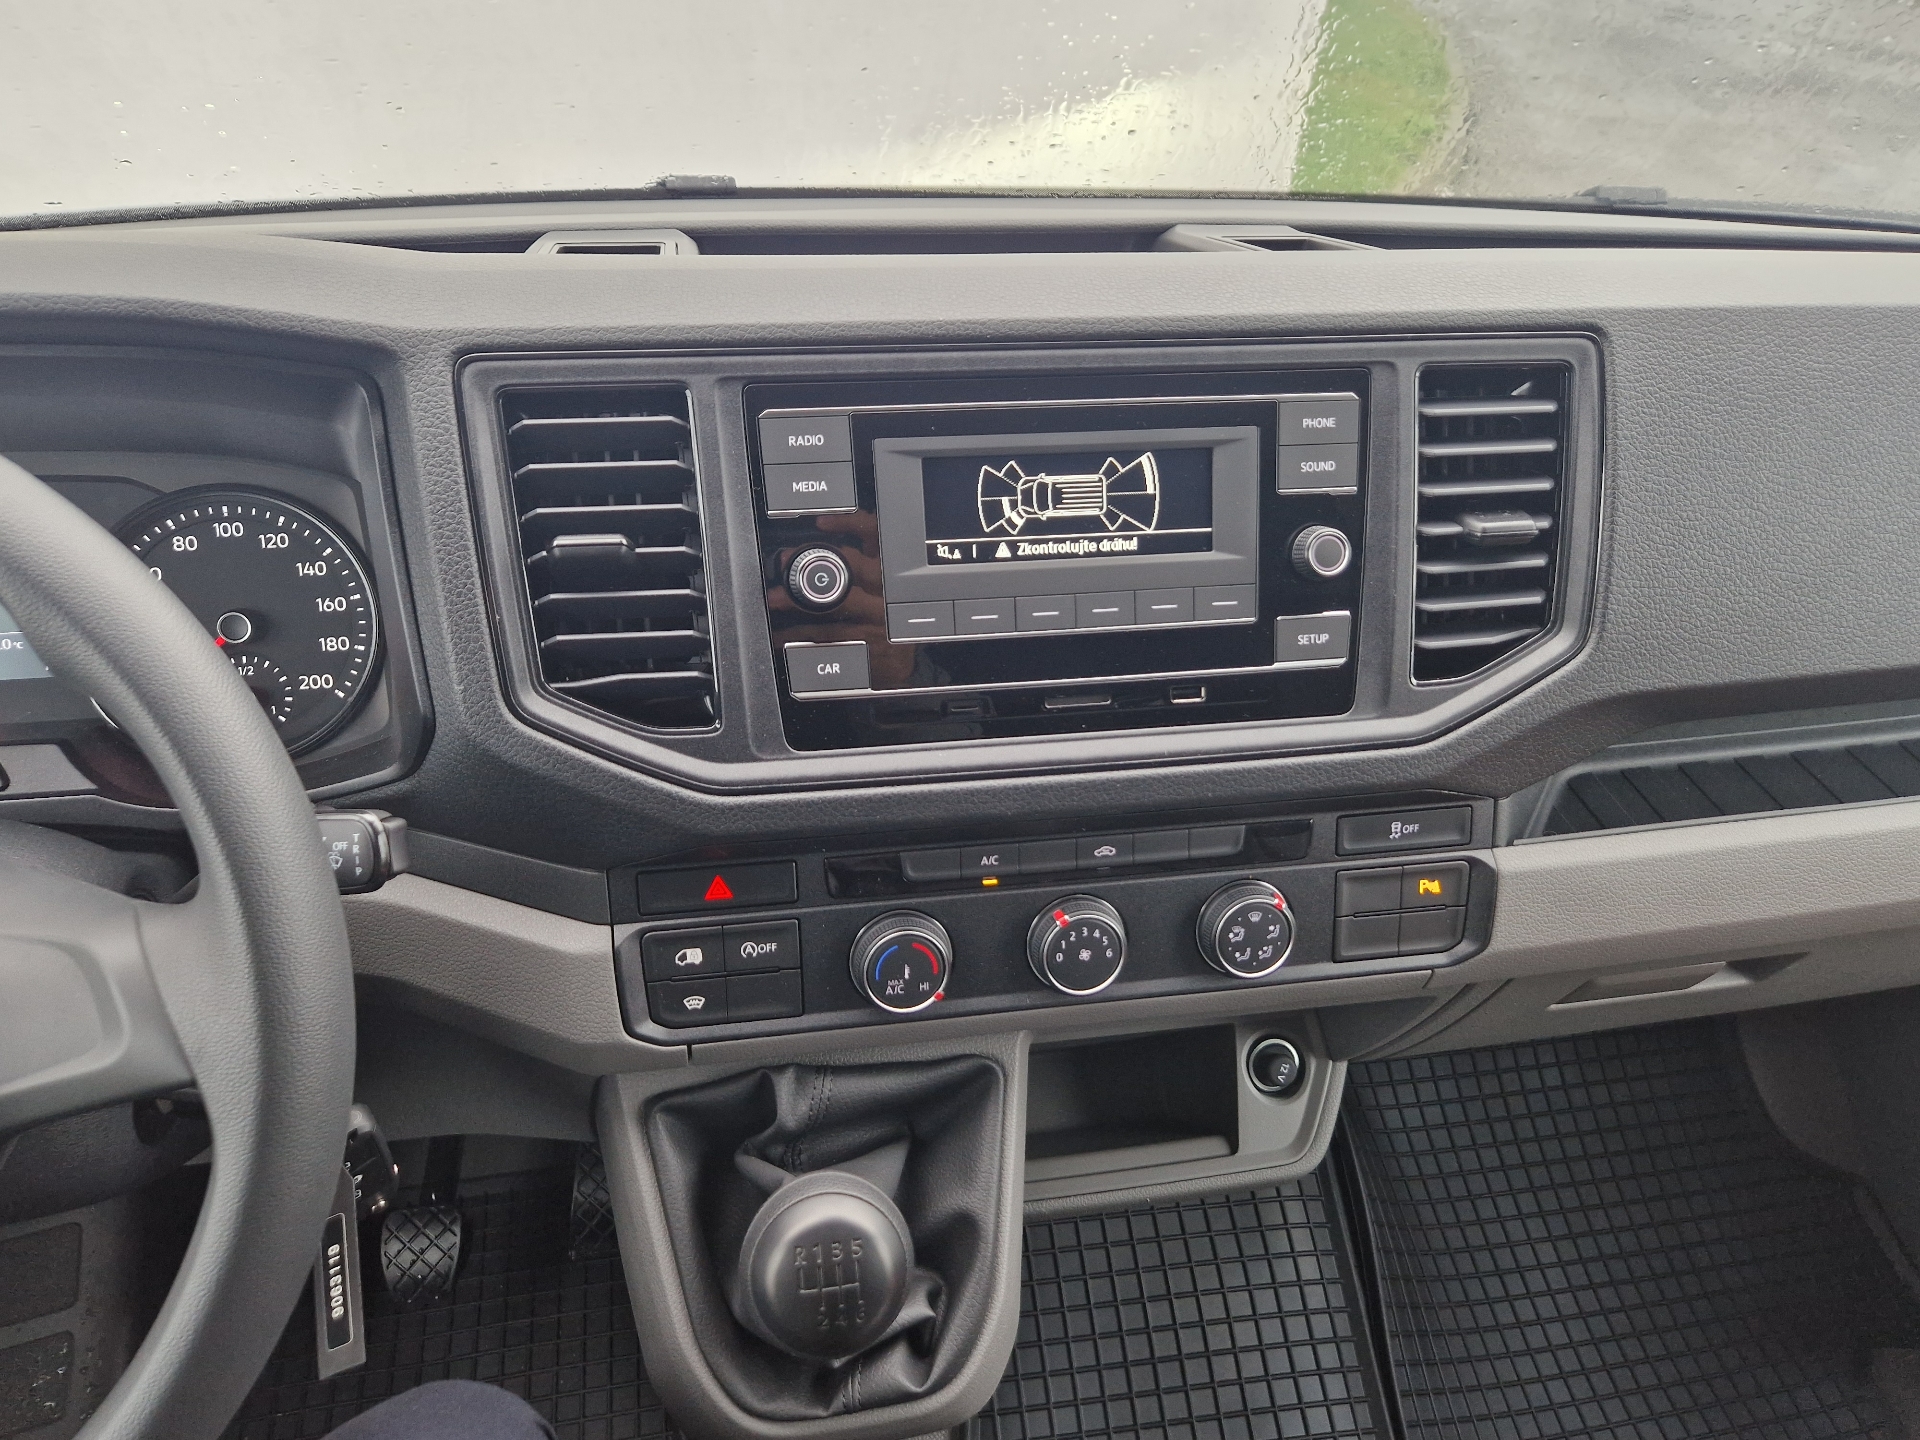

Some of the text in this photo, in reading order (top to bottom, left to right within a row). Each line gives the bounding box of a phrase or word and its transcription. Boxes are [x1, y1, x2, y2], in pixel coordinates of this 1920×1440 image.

[1302, 417, 1336, 428] PHONE
[788, 434, 824, 446] RADIO
[1300, 460, 1336, 472] SOUND
[792, 480, 828, 492] MEDIA
[213, 521, 244, 537] 100
[172, 535, 198, 551] 80
[258, 533, 289, 549] 120
[1016, 536, 1138, 556] Zkontrolujte dráhu!
[295, 561, 327, 577] 140
[315, 596, 347, 612] 160
[318, 636, 350, 652] 180
[1297, 633, 1330, 645] SETUP
[237, 665, 255, 676] 1/2
[817, 662, 841, 675] CAR
[298, 673, 334, 690] 200
[270, 705, 277, 715] 1
[1402, 823, 1420, 834] OFF
[332, 841, 349, 851] OFF
[352, 833, 363, 876] TRIP
[980, 854, 999, 866] A/C
[757, 942, 778, 954] OFF
[1055, 926, 1113, 962] 0 1 2 3 4 5 6
[885, 984, 905, 995] A/C
[919, 981, 930, 992] HI
[1277, 1062, 1290, 1083] 12 V
[812, 1241, 823, 1264] 1
[831, 1240, 843, 1262] 3
[851, 1237, 863, 1259] 5
